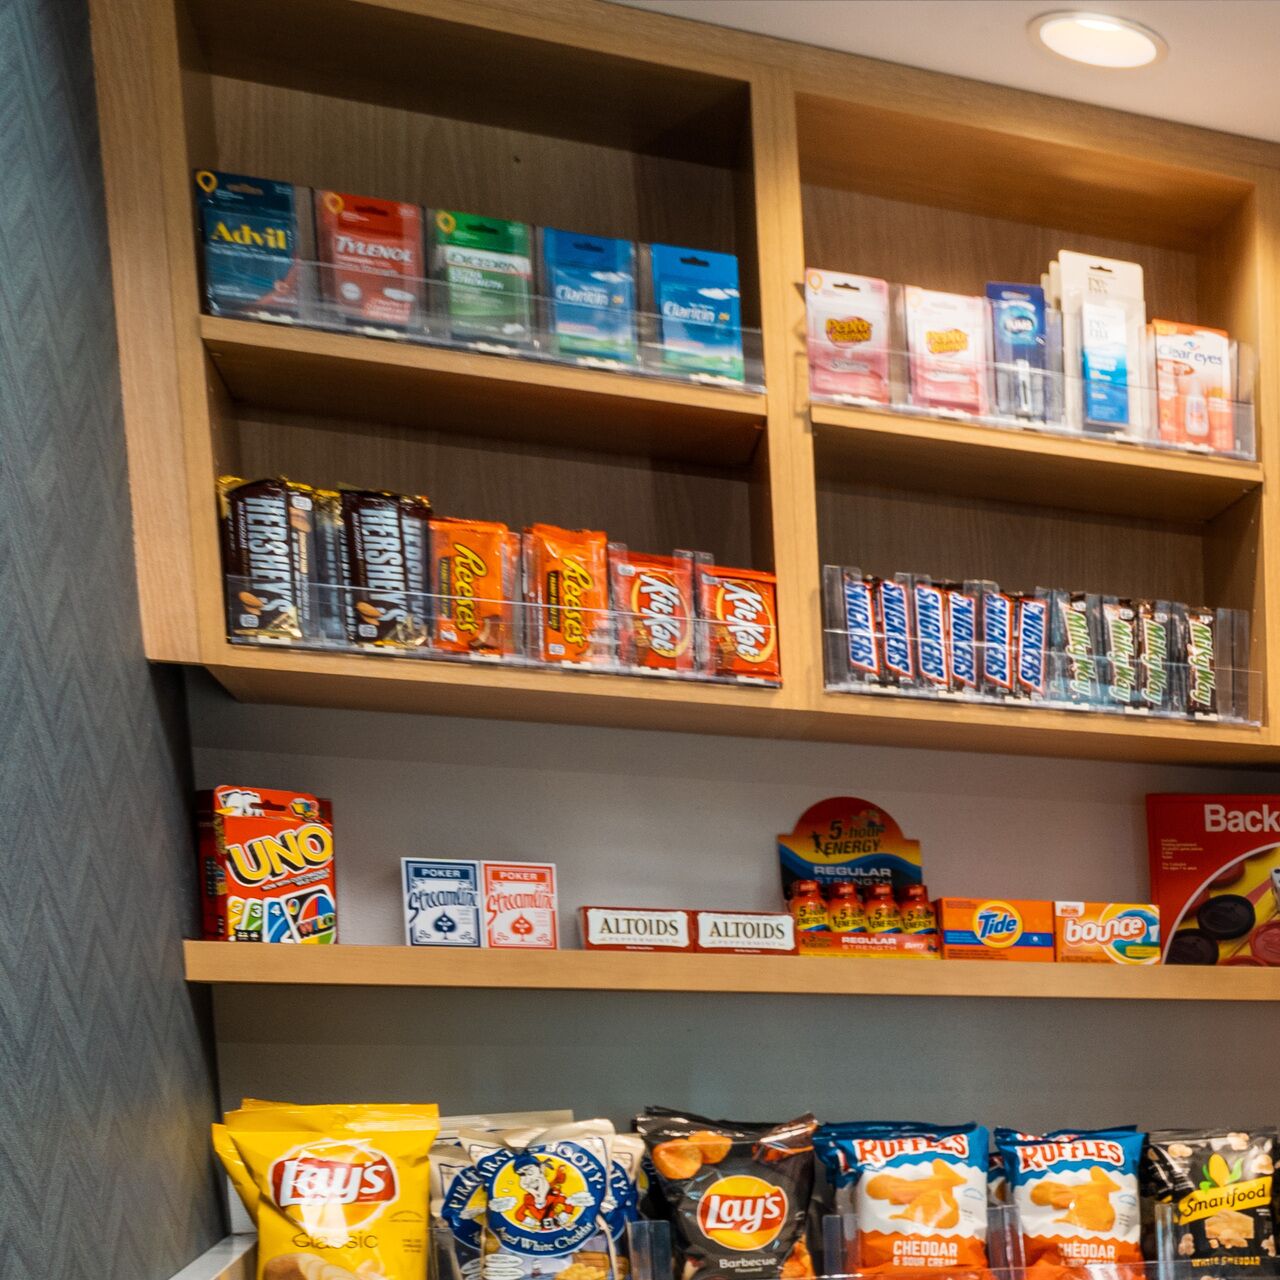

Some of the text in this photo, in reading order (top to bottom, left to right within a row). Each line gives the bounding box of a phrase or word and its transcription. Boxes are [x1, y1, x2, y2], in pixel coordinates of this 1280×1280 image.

[209, 221, 287, 252] Advil
[336, 236, 413, 263] TYLENOL
[662, 301, 715, 323] Claritin
[245, 497, 294, 614] HERSHEY'S
[361, 505, 404, 624] HERSHEY'S
[453, 543, 487, 633] Reese's
[563, 556, 594, 647] Reese's
[846, 580, 876, 667] SNICKERS
[881, 581, 910, 675] SNICKERS
[916, 587, 947, 683] SNICKERS
[950, 591, 976, 687] SNICKERS
[984, 593, 1012, 688] SNICKERS
[1018, 600, 1046, 690] SNICKERS
[227, 823, 334, 886] UNO
[824, 840, 881, 855] ENERGY
[421, 868, 461, 879] POKER
[499, 871, 538, 882] POKER
[813, 866, 892, 877] REGULAR
[600, 917, 679, 936] ALTOIDS
[709, 921, 785, 939] ALTOIDS
[842, 937, 896, 945] REGULAR
[978, 913, 1017, 938] Tide
[1065, 917, 1142, 942] bounce
[855, 1133, 969, 1164] RUFFLES
[1018, 1139, 1125, 1172] RUFFLES
[280, 1158, 388, 1208] Lay's
[705, 1192, 782, 1233] Lay's
[1183, 1186, 1267, 1216] Smartfood
[719, 1257, 777, 1269] Barbecue
[893, 1241, 958, 1257] CHEDDAR
